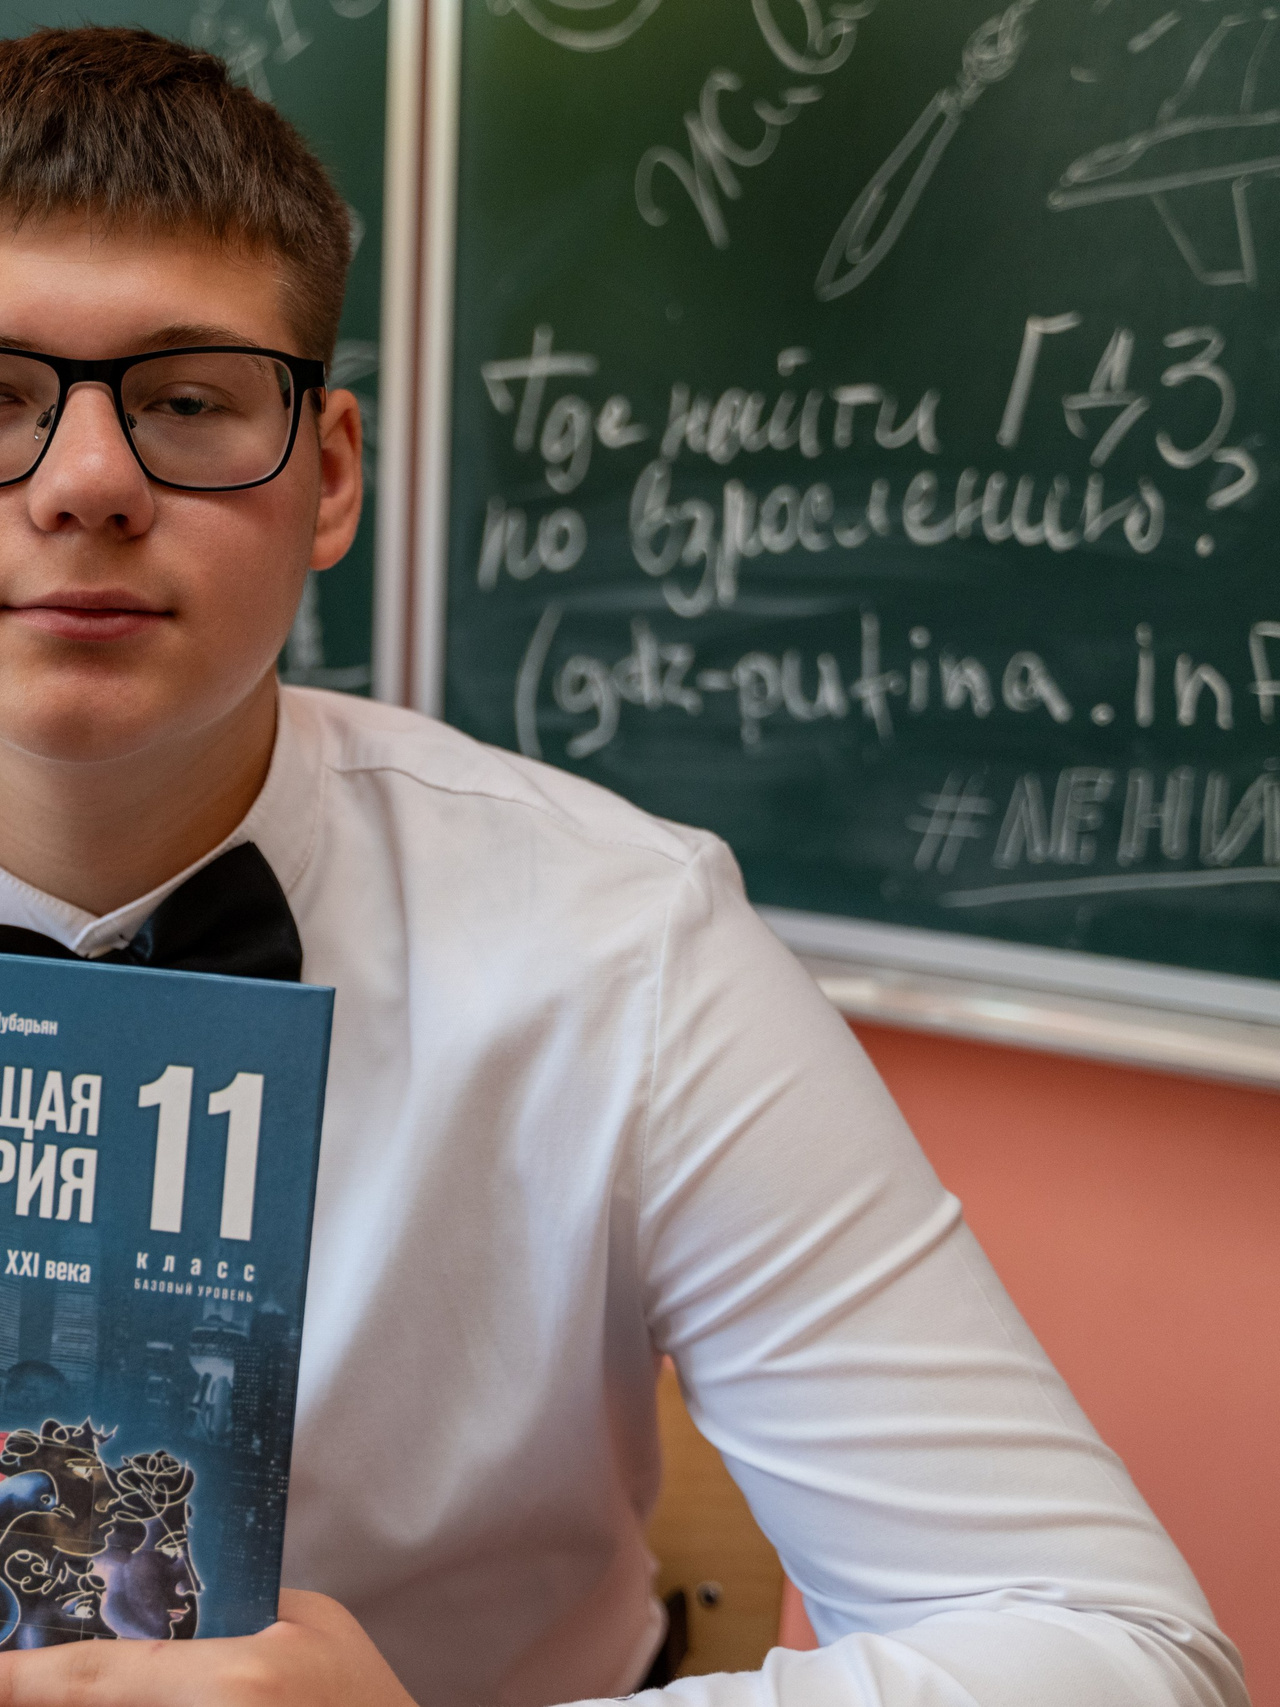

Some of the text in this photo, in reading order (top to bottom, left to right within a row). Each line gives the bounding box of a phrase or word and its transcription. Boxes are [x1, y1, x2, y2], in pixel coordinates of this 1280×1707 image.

[481, 310, 1237, 494] Где найти ГДЗ
[477, 494, 587, 592] по
[137, 1064, 265, 1241] 11
[4, 1249, 40, 1278] XXI
[45, 1261, 91, 1284] века
[134, 1278, 254, 1302] БАЗОВЫЙ УРОВЕНЬ
[136, 1251, 256, 1282] класс
